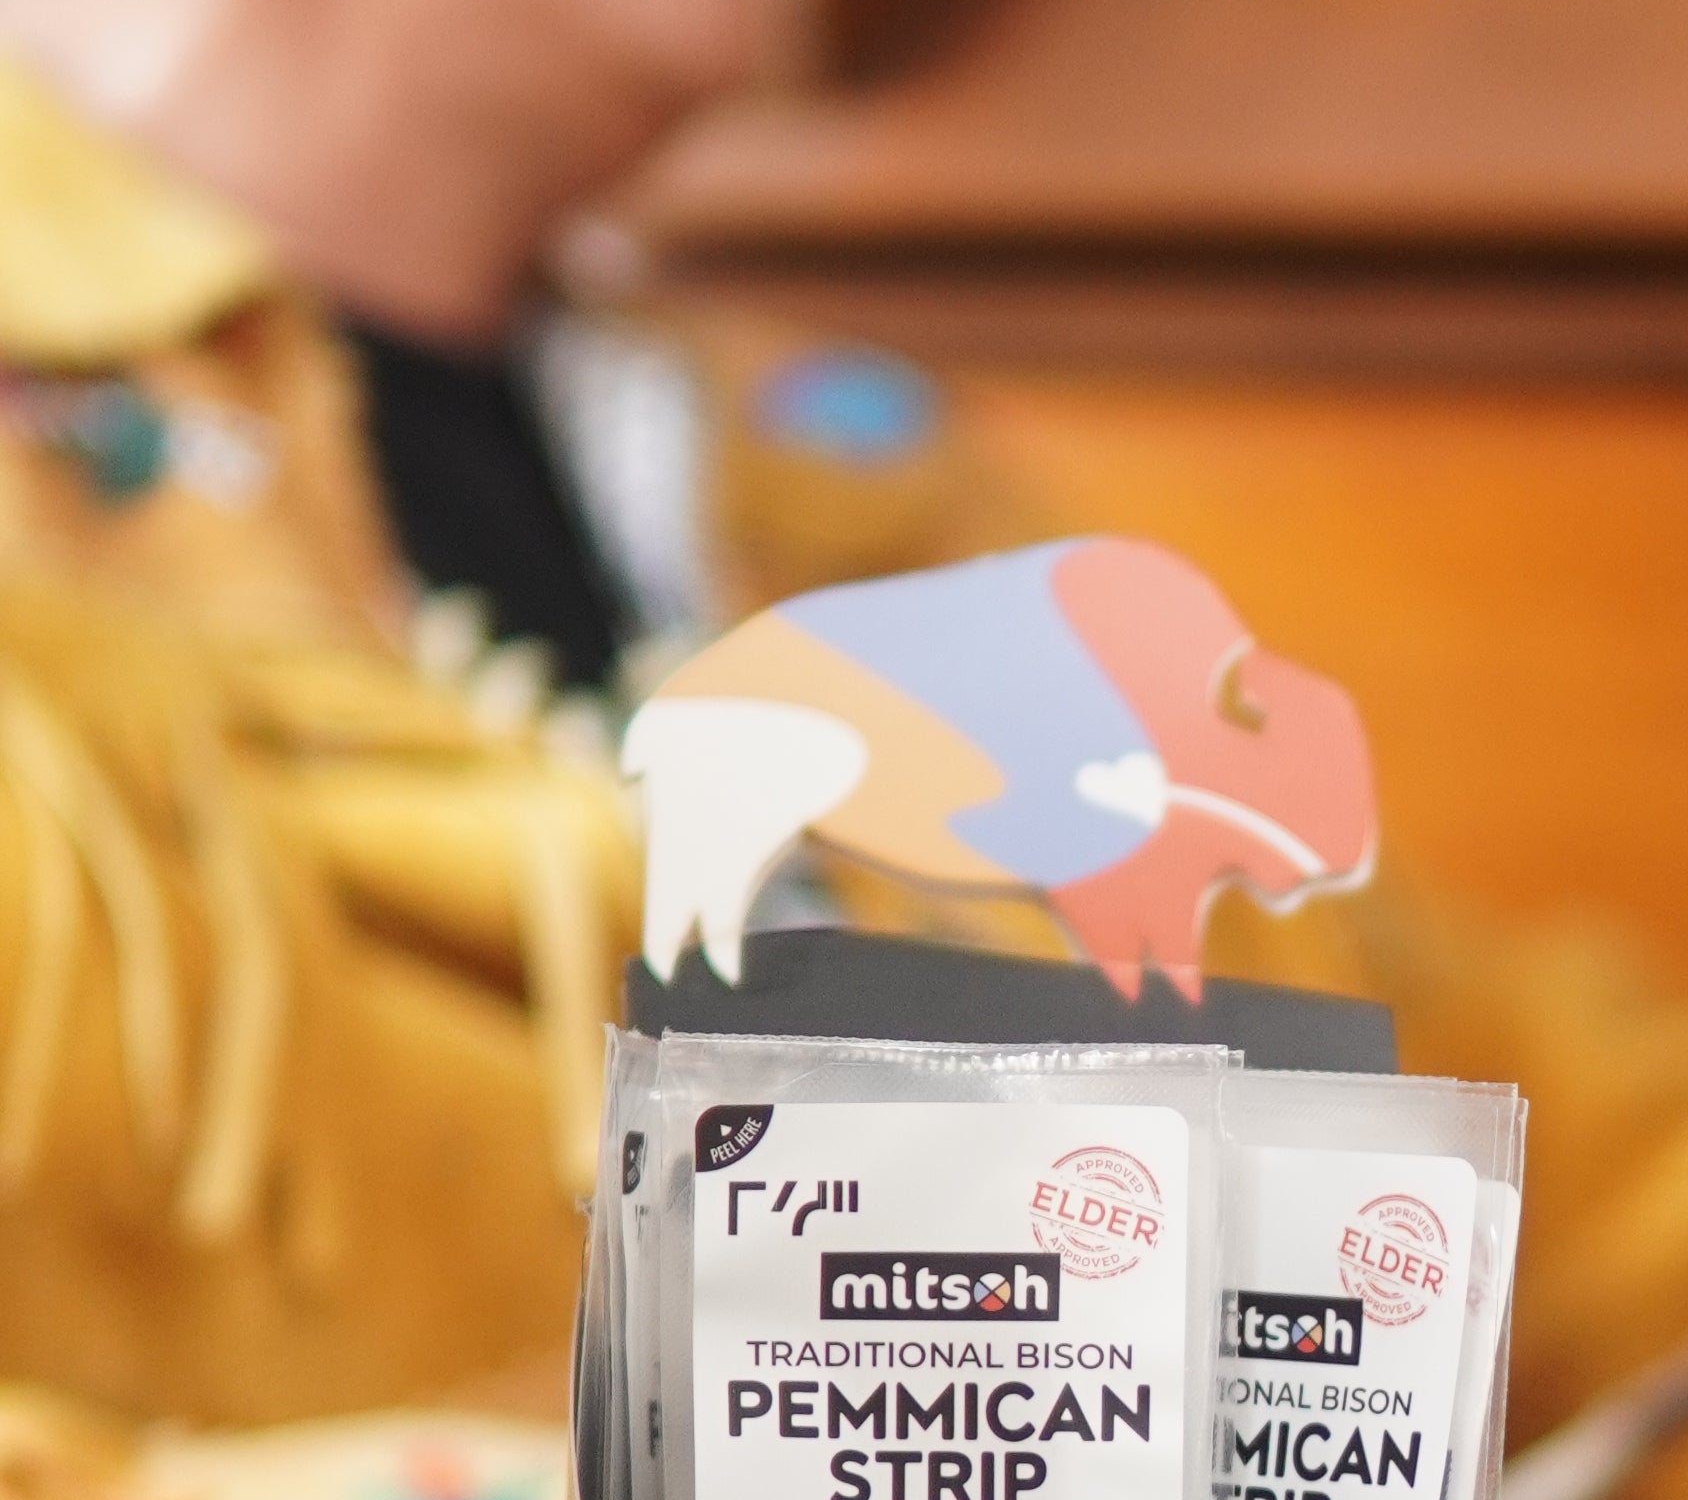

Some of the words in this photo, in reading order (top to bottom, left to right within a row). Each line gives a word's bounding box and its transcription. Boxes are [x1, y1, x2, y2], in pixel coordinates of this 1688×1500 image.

[710, 1141, 740, 1164] PEEL
[734, 1116, 762, 1146] HERE
[1076, 1159, 1144, 1193] APPROVED
[1032, 1182, 1159, 1246] ELDER
[1378, 1207, 1435, 1242] APPROVED
[1051, 1236, 1120, 1267] APPROVED
[1340, 1227, 1443, 1294] ELDER
[831, 1263, 1050, 1311] mitsoh
[1354, 1283, 1411, 1314] APPROVED
[747, 1341, 1003, 1368] TRADITIONAL
[1018, 1343, 1132, 1369] BISON
[728, 1381, 1150, 1442] PEMMICAN
[1322, 1386, 1412, 1416] BISON
[1213, 1419, 1421, 1488] MICAN
